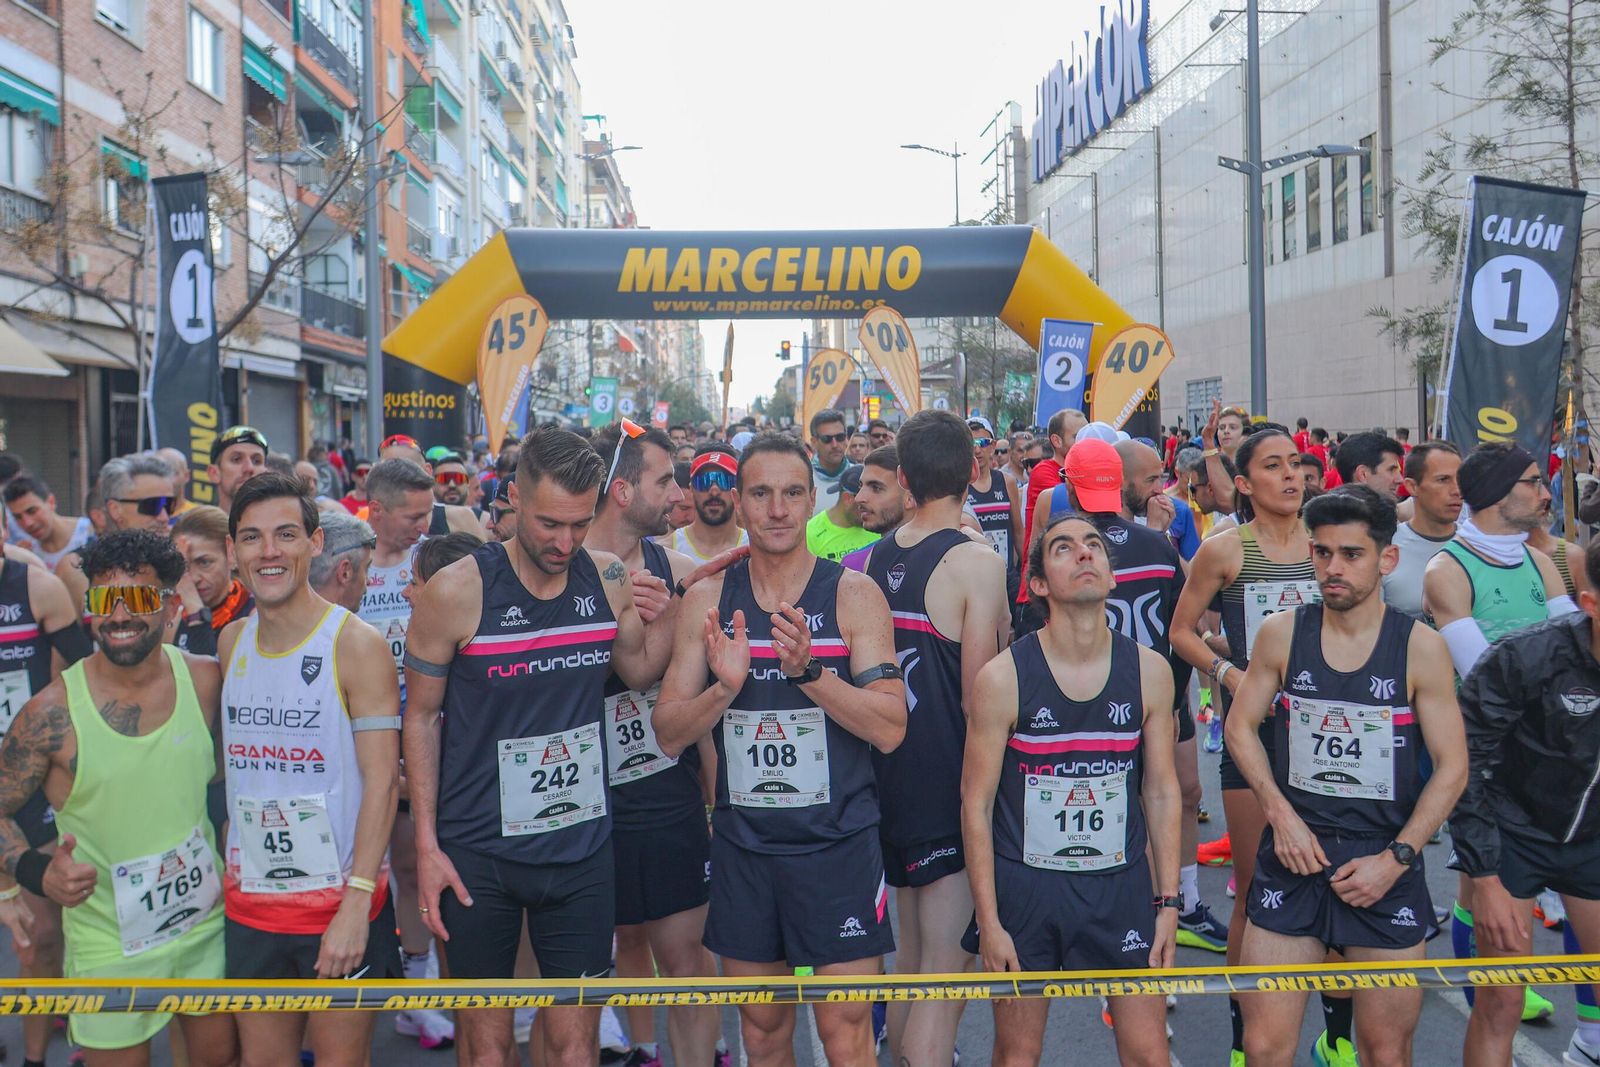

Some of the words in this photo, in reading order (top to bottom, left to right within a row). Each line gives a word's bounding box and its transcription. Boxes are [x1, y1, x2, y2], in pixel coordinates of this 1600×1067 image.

[1031, 0, 1154, 185] HIPERCOR
[1481, 213, 1564, 253] CAJÓN
[616, 244, 922, 293] MARCELINO
[186, 263, 205, 329] 1
[652, 294, 886, 314] www.mpmarcelino.es
[1493, 267, 1529, 334] 1
[1048, 332, 1086, 350] CAJÓN
[1105, 340, 1165, 374] 40'
[1054, 356, 1073, 386] 2
[598, 394, 609, 412] 3
[500, 619, 531, 627] austral
[487, 649, 611, 679] runrundata
[1291, 683, 1319, 692] austral
[615, 719, 645, 746] 38
[1030, 720, 1060, 729] austral
[623, 741, 646, 754] CARLOS
[746, 743, 798, 768] 108
[1311, 732, 1363, 760] 764
[762, 769, 784, 777] EMILIO
[1329, 759, 1360, 769] ANTONIO
[530, 762, 580, 794] 242
[542, 789, 572, 802] CESAREO
[548, 807, 564, 815] CAJÓN
[1054, 809, 1105, 832] 116
[263, 831, 294, 854] 45
[1068, 848, 1085, 856] CAJÓN
[139, 865, 203, 912] 1769
[1391, 918, 1419, 928] austral
[839, 929, 868, 938] austral
[1122, 942, 1149, 953] austral
[1042, 979, 1205, 998] MARCELINO
[1256, 972, 1419, 992] MARCELINO
[156, 993, 333, 1013] MARCELINO
[383, 993, 556, 1011] MARCELINO
[606, 990, 775, 1007] MARCELINO
[826, 986, 991, 1002] MARCELINO
